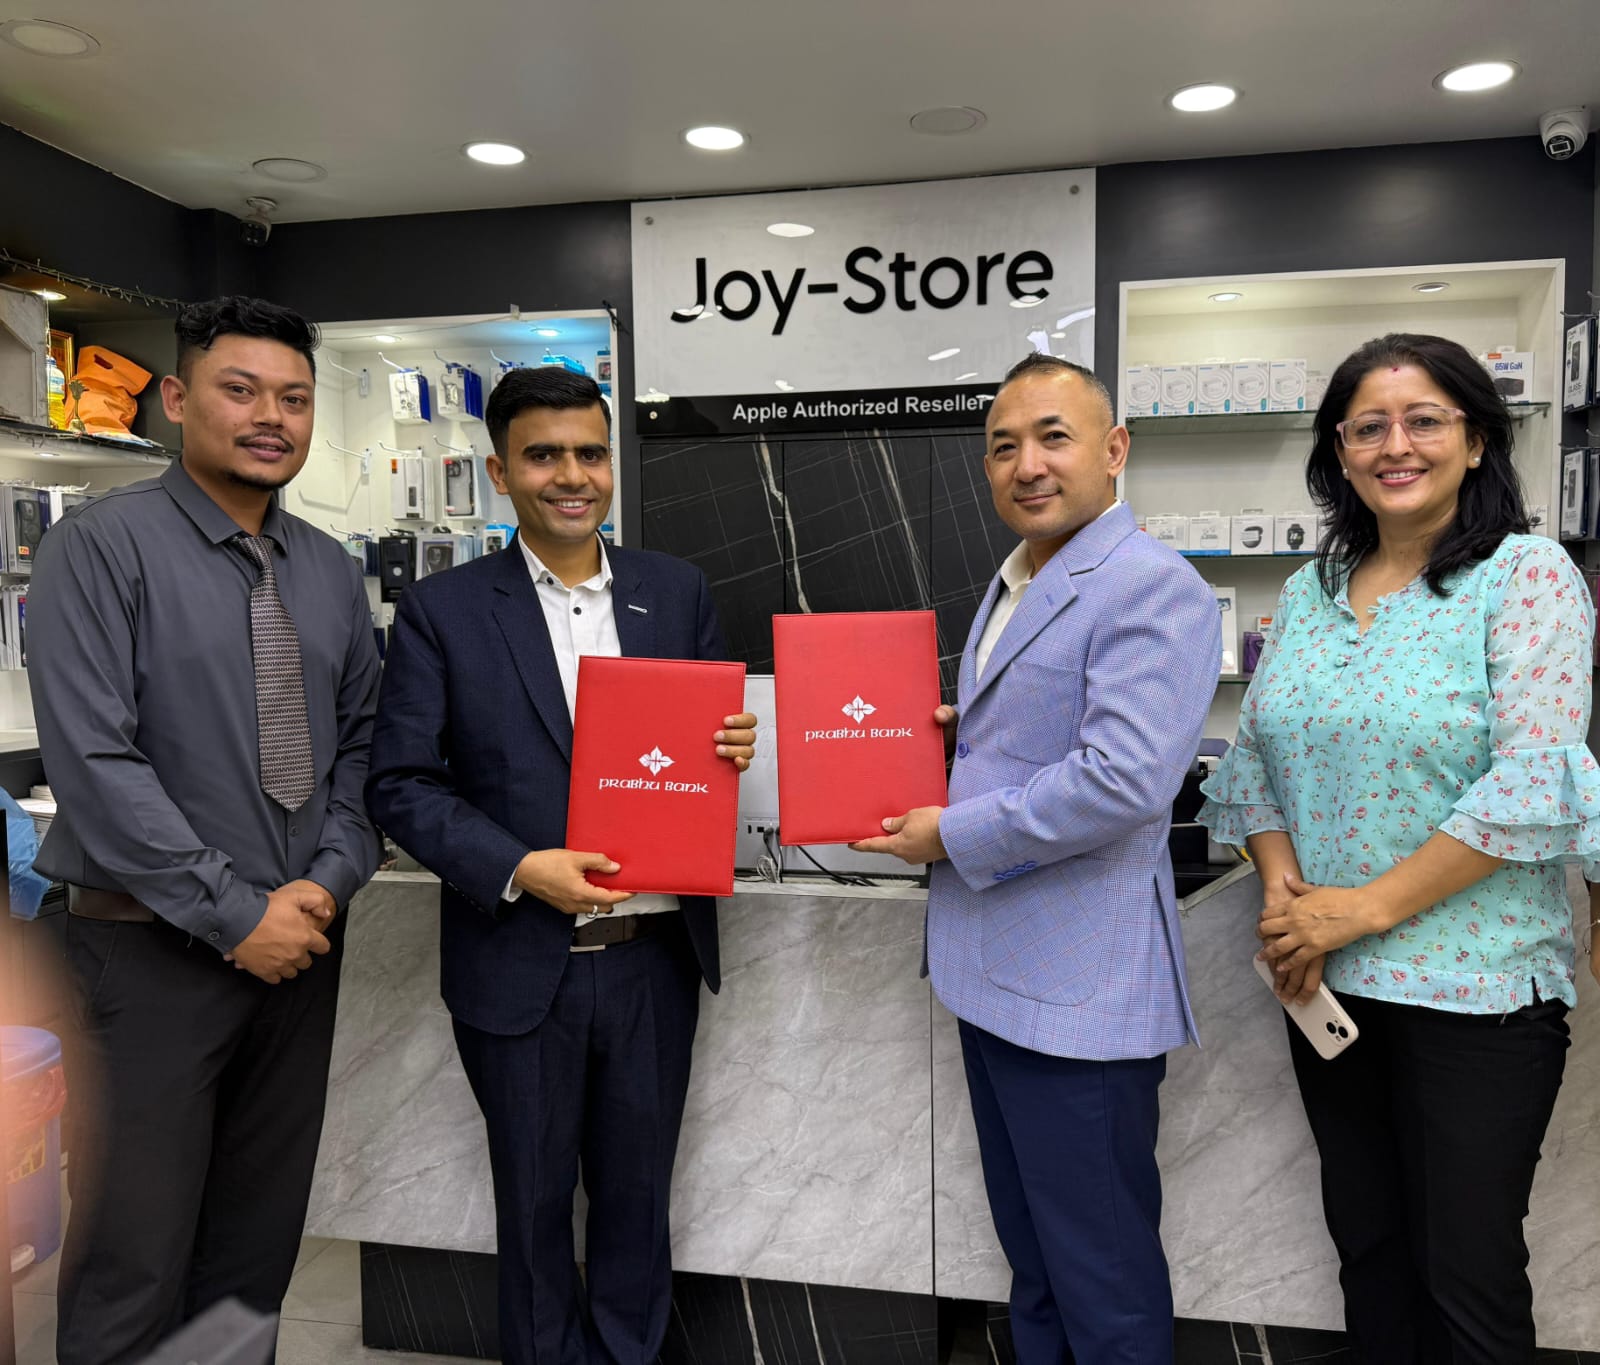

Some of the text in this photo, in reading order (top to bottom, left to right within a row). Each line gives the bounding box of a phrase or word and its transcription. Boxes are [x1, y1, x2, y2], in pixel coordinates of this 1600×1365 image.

[670, 246, 1054, 336] Joy-Store
[732, 394, 986, 423] Apple Authorized Reseller
